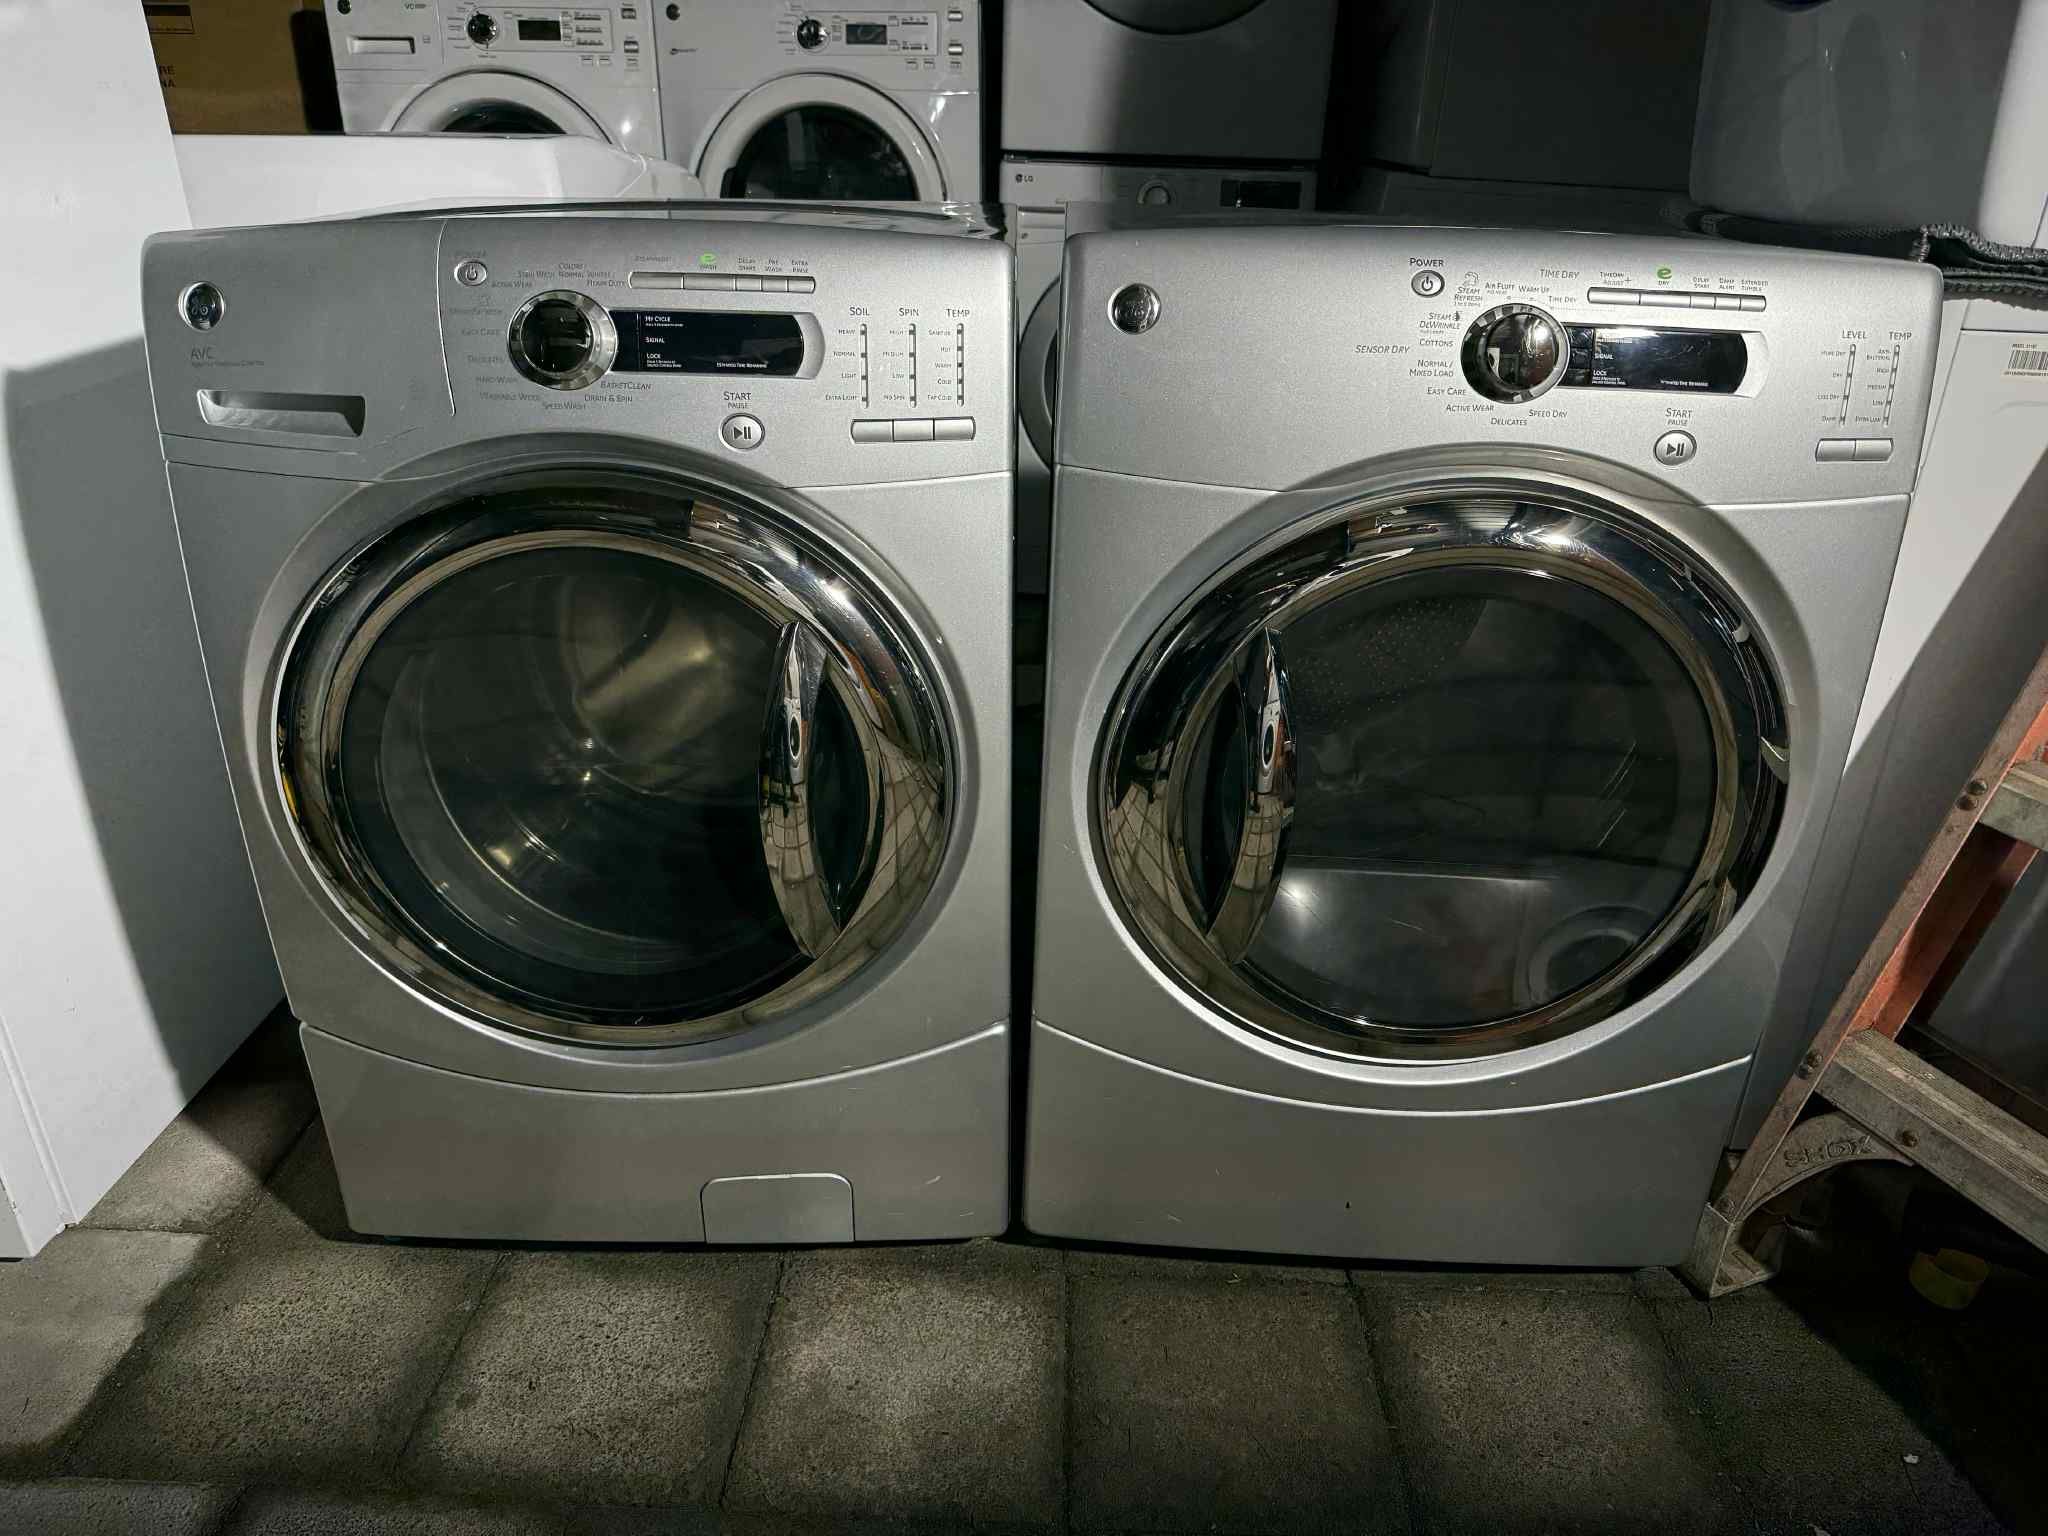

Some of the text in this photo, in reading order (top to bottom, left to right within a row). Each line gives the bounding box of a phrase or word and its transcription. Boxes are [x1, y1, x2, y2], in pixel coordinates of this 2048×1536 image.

[1409, 257, 1444, 268] POWER
[1539, 268, 1580, 280] TIME DRY
[1457, 286, 1480, 294] STEAM
[1518, 285, 1540, 293] WARM
[1454, 294, 1483, 302] REFRESH
[849, 306, 870, 316] SOIL
[898, 307, 919, 317] SPIN
[946, 308, 970, 318] TEMP
[1428, 312, 1452, 321] STEAM
[1842, 330, 1867, 340] LEVEL
[1889, 331, 1912, 341] TEMP
[1419, 338, 1454, 347] COTTONS
[1355, 344, 1411, 354] SENSOR DRY
[1409, 368, 1454, 377] MIXED LOAD
[723, 391, 752, 401] START
[1427, 387, 1467, 396] EASY CARE
[727, 402, 749, 410] PAUSE
[1446, 404, 1494, 412] ACTIVE WEAR
[1528, 409, 1568, 418] SPEED DRY
[1665, 407, 1693, 419] START
[1490, 417, 1528, 426] DELICATES
[1667, 419, 1688, 427] PAUSE
